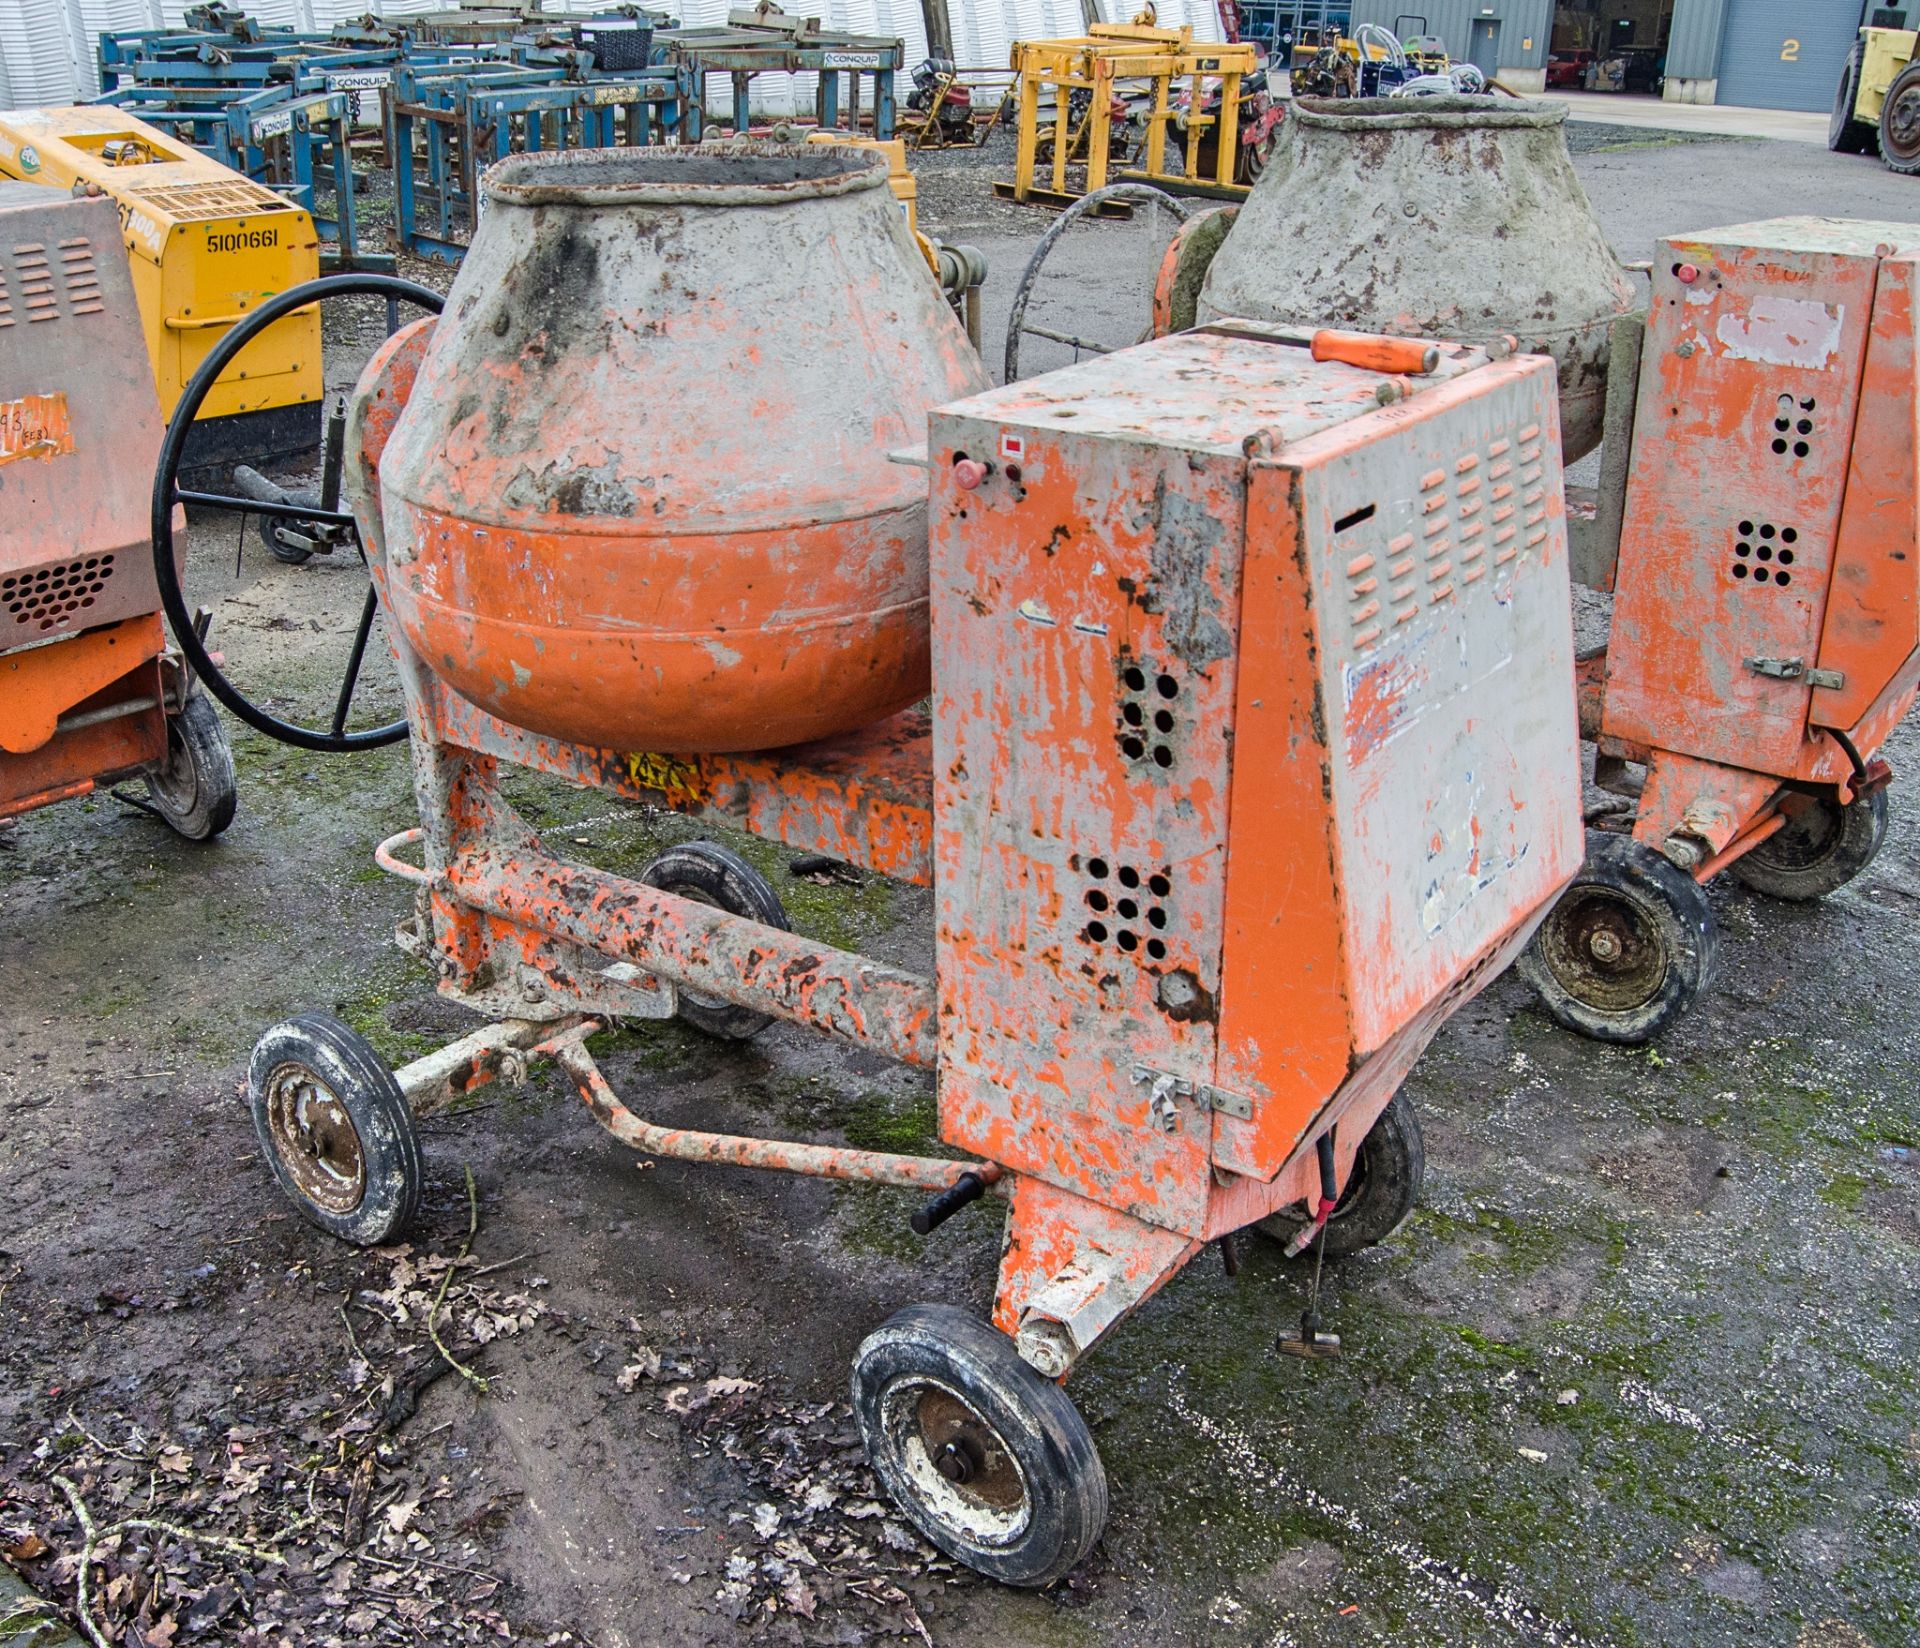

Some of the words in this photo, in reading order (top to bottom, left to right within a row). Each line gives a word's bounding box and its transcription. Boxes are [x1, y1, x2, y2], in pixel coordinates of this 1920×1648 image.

[1780, 38, 1800, 61] 2
[833, 54, 879, 64] CONQUIP
[337, 76, 387, 88] CONQUIP
[207, 228, 278, 253] 5100661
